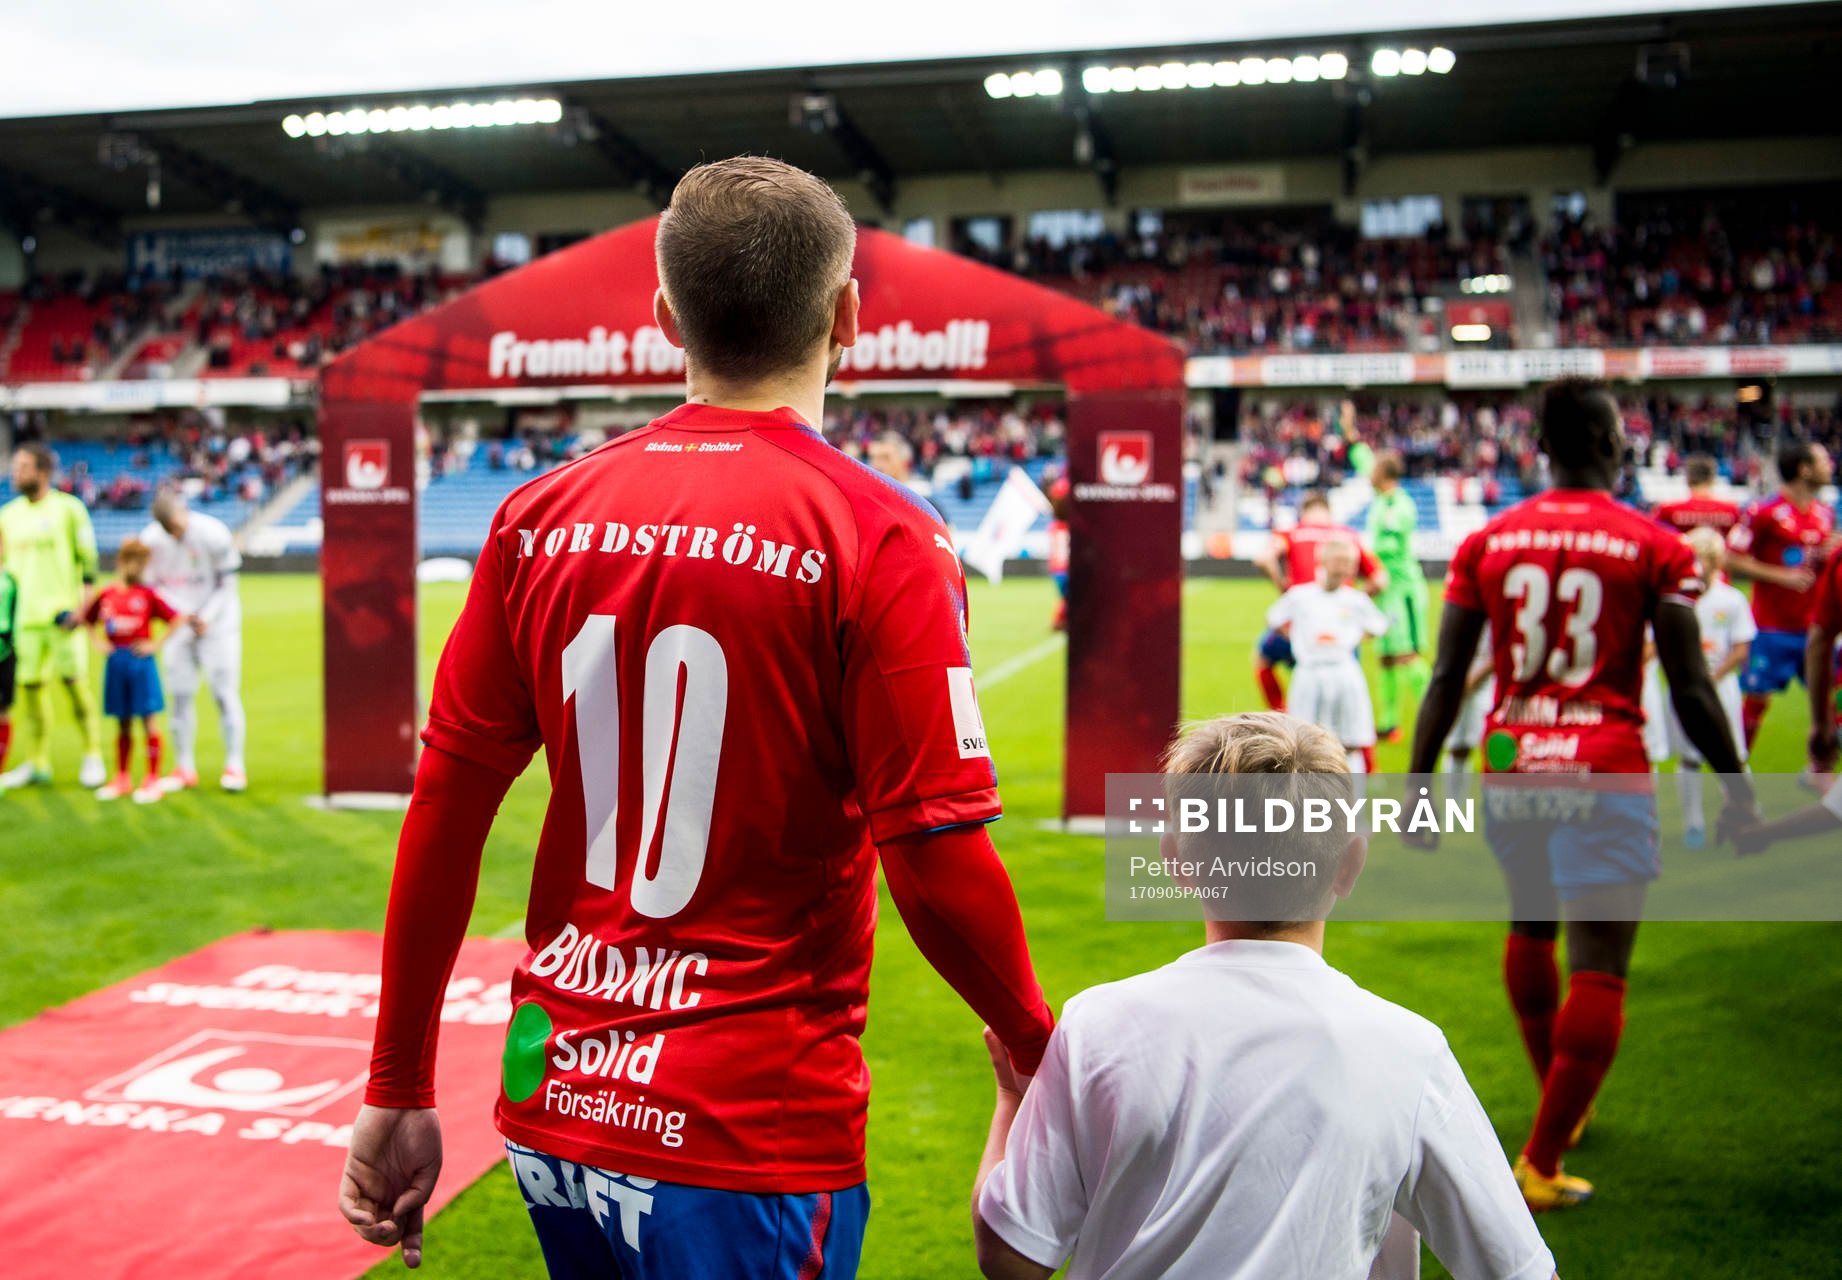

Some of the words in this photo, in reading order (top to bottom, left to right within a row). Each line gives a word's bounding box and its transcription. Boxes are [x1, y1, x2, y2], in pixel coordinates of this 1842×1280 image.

[488, 325, 627, 379] Framåt
[698, 442, 744, 452] Stolthet
[516, 521, 827, 585] NORDSTRÖMS
[1502, 562, 1604, 689] 33
[562, 614, 728, 919] 10
[529, 923, 709, 1011] BOJANIC
[552, 1029, 666, 1086] Solid
[545, 1079, 687, 1148] Försäkring
